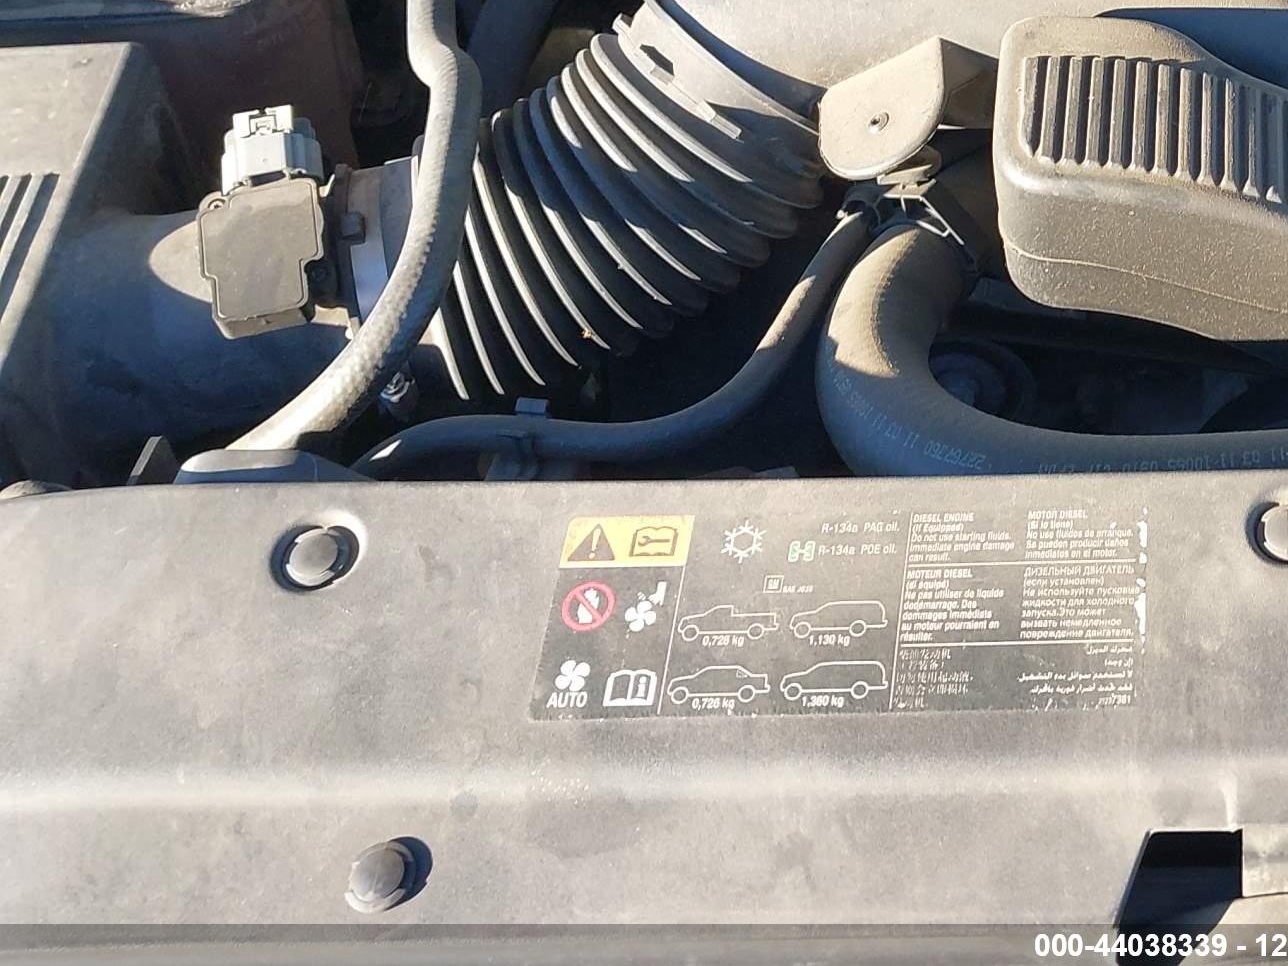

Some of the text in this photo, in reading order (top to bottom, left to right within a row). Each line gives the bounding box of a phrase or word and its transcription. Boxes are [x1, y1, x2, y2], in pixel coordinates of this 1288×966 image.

[913, 513, 974, 523] DIESEL ENGINE
[822, 522, 900, 534] R-134a PAG oil.
[955, 533, 986, 542] starting
[1027, 530, 1037, 539] No
[1084, 529, 1094, 538] de
[818, 543, 897, 555] R-134a POE oil.
[954, 543, 981, 552] engine
[982, 542, 1015, 551] damage
[1026, 540, 1036, 548] Se
[1038, 540, 1068, 549] pueden
[1070, 539, 1103, 549] producir
[907, 569, 973, 579] MOTEUR DIESEL
[1024, 565, 1134, 577] ДИЗЕЛЬНЫЙ ДВИГАТЕЛЬ
[1049, 576, 1104, 588] установлен)
[919, 592, 933, 600] pas
[935, 590, 963, 599] utiliser
[964, 589, 974, 598] de
[976, 588, 1005, 599] liquide
[1023, 588, 1035, 596] Не
[1022, 597, 1135, 607] жидкости для холодного
[902, 611, 947, 621] dommages
[901, 622, 912, 630] au
[914, 622, 943, 630] moteur
[988, 620, 1000, 629] en
[1021, 619, 1058, 628] вызвать
[732, 635, 744, 648] kg
[810, 634, 850, 646] 1,130 kg
[546, 692, 588, 708] AUTO
[722, 698, 736, 710] kg
[830, 694, 845, 708] kg
